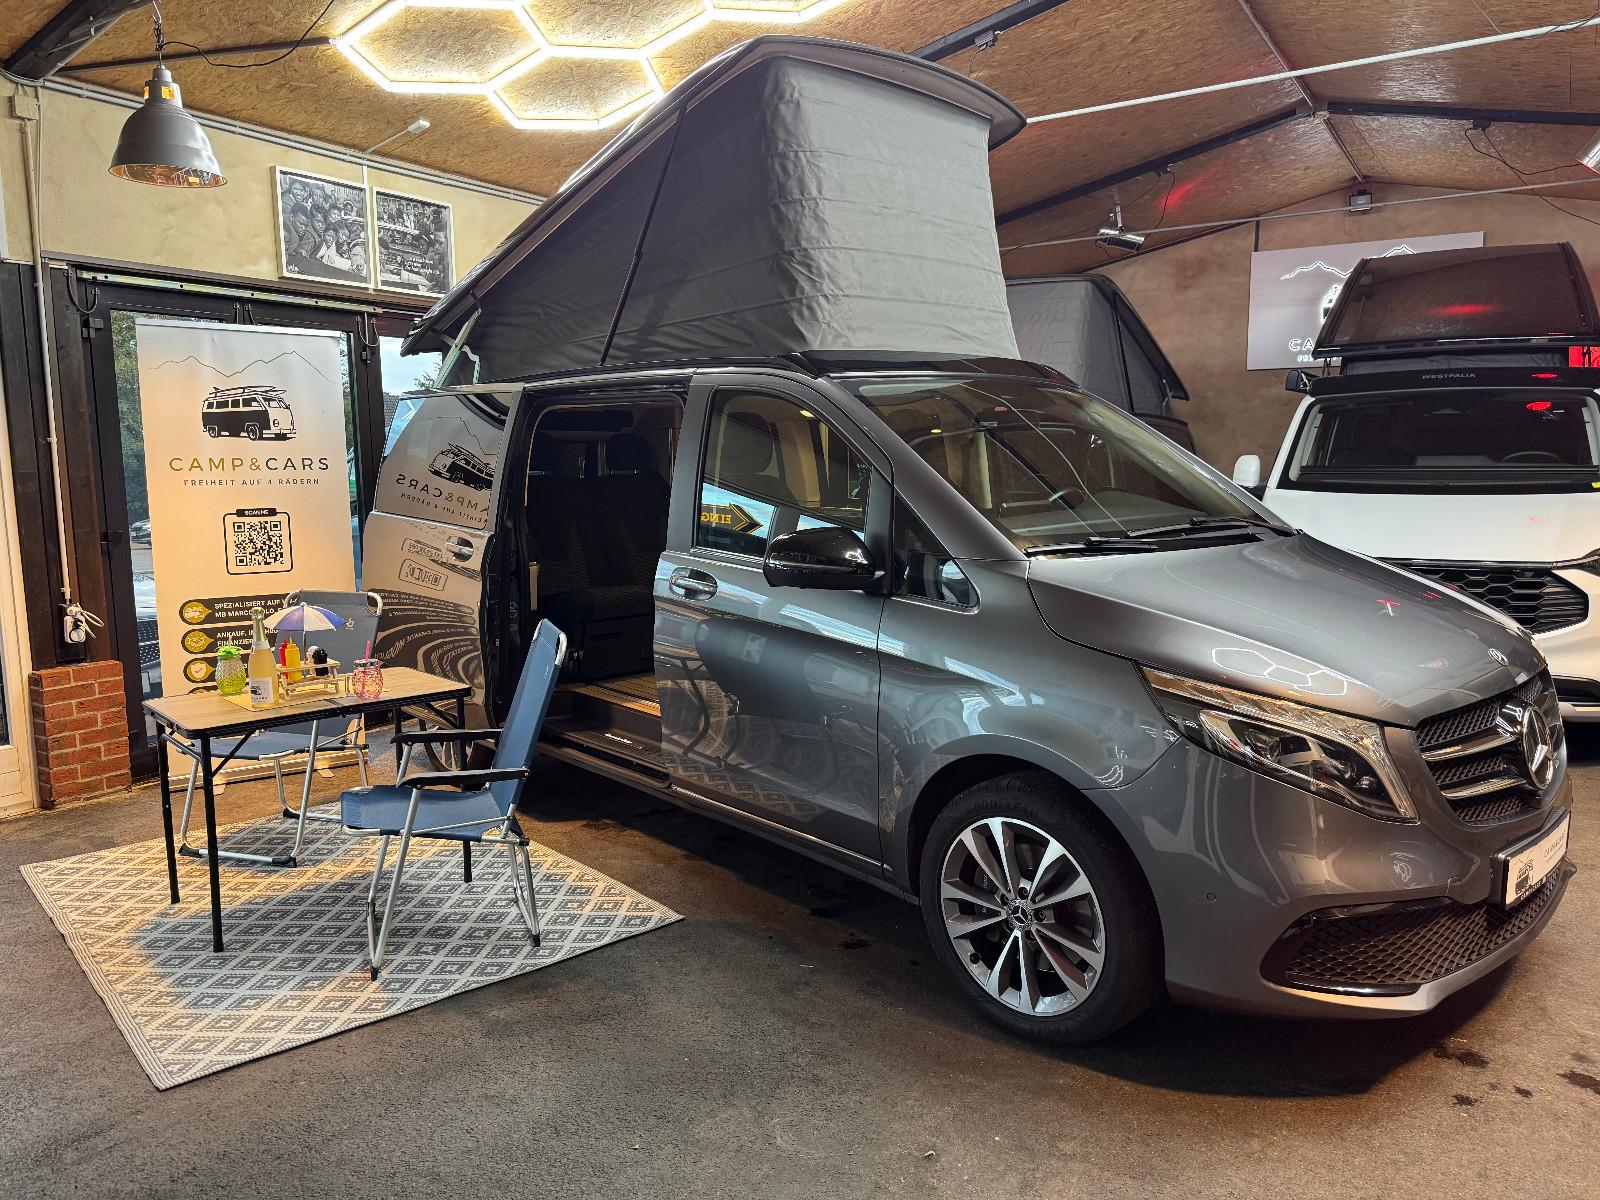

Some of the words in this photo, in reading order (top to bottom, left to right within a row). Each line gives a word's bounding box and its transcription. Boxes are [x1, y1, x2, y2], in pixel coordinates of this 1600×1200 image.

[168, 457, 329, 472] CAMP&CARS
[183, 479, 236, 487] FREIHEIT
[241, 478, 262, 486] AUF
[278, 476, 320, 485] RÄDERN
[214, 600, 265, 610] SPEZIALISIERT
[216, 630, 247, 639] ANKAUF,
